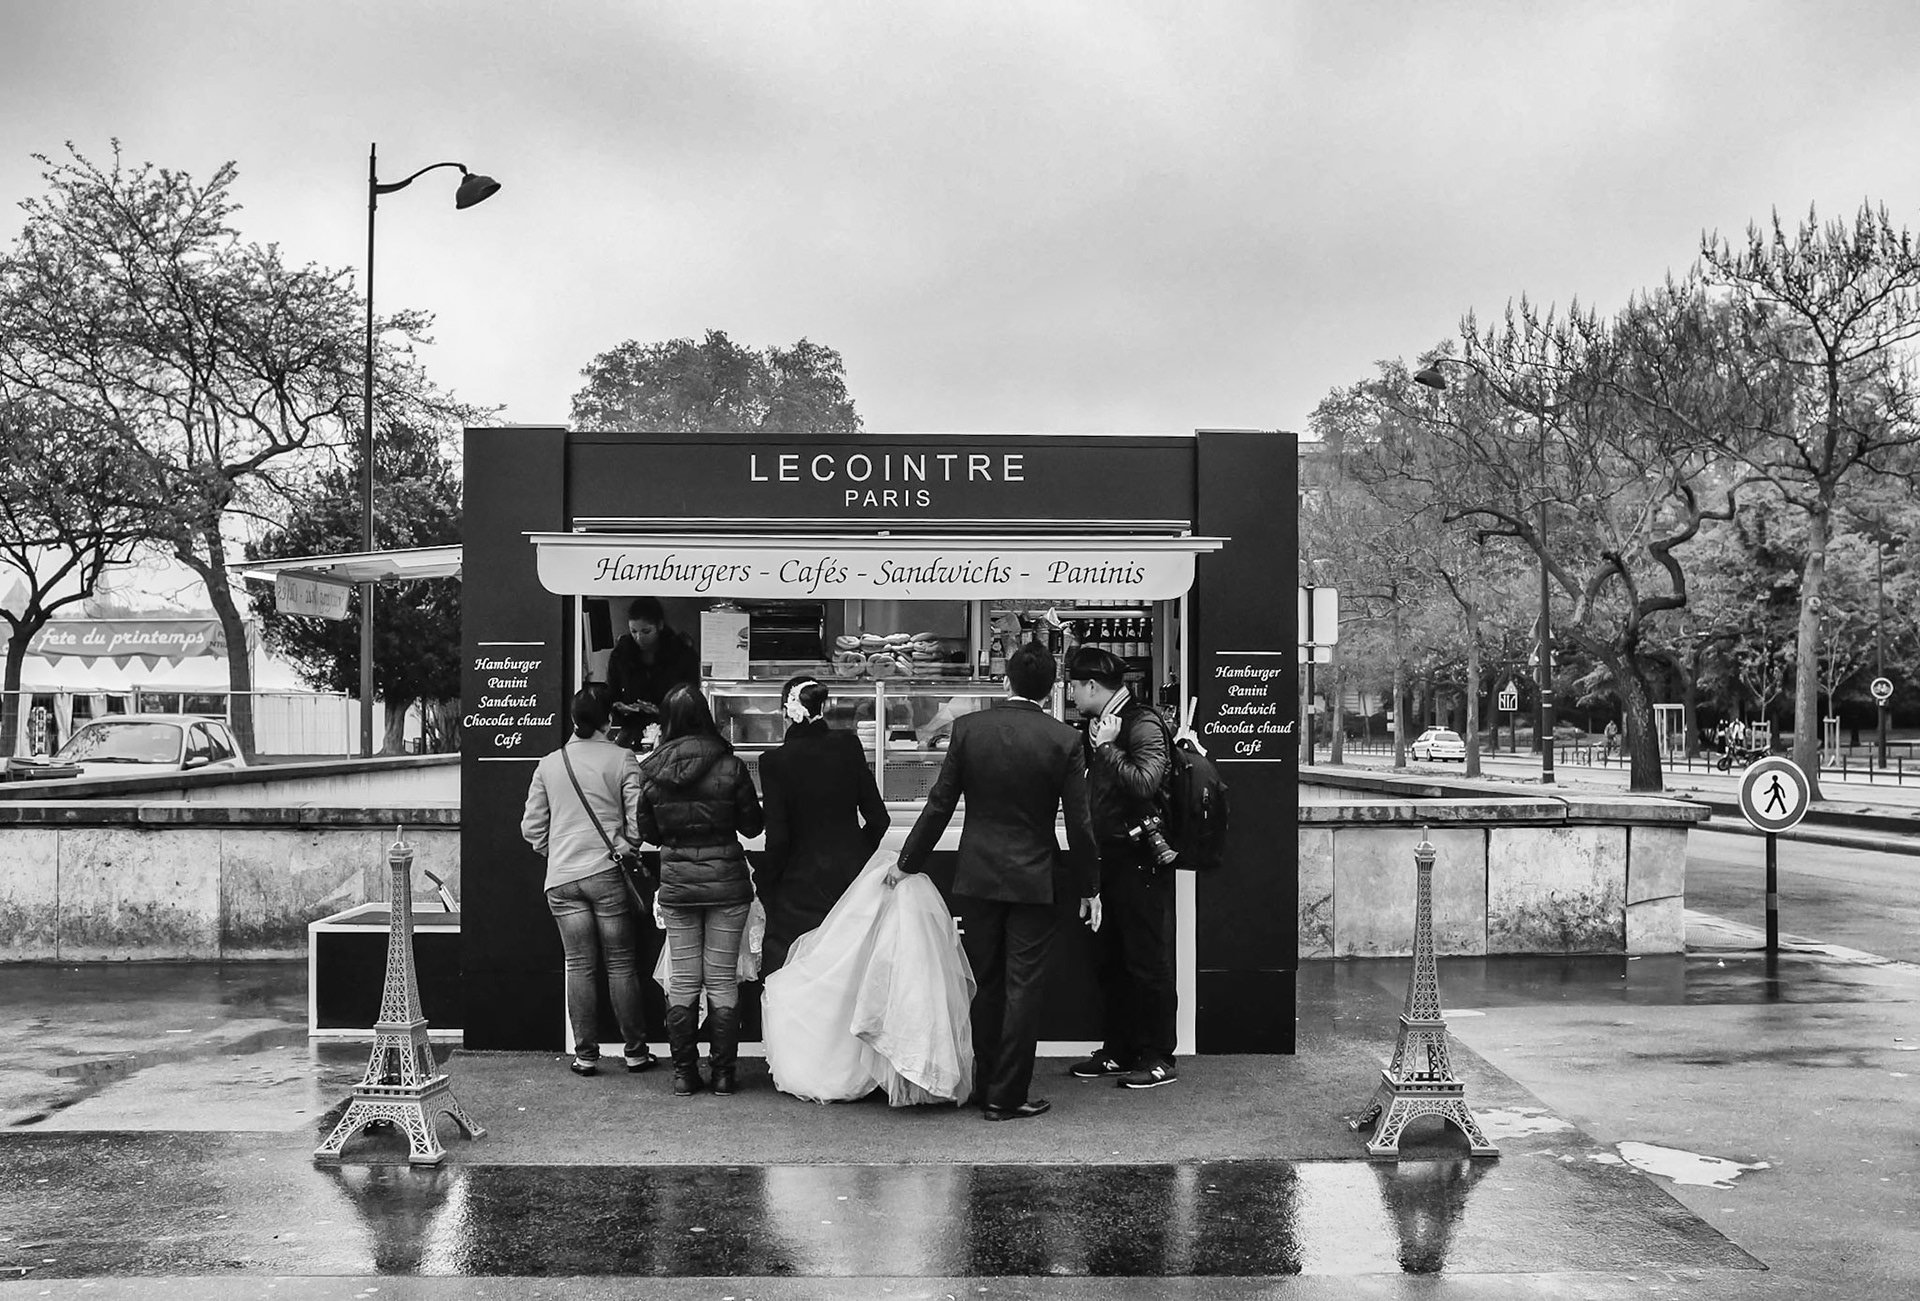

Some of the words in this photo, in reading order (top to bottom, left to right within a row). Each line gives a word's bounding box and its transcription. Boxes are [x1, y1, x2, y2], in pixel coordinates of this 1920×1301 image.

[750, 453, 1025, 482] LECOINTRE
[845, 489, 932, 508] PARIS
[593, 554, 752, 593] Hamburgers
[779, 557, 849, 593] Cafés
[873, 556, 1012, 586] Sandwichs
[1047, 560, 1146, 584] Paninis
[82, 627, 106, 645] du
[106, 630, 205, 653] printemps
[473, 656, 542, 673] Hamburger
[1214, 664, 1282, 682] Hamburger
[487, 676, 529, 689] Panini
[1227, 684, 1269, 697] Panini
[478, 694, 537, 708] Sandwich
[1218, 702, 1277, 716] Sandwich
[463, 713, 515, 728] Chocolat
[516, 713, 556, 726] chaud
[1204, 720, 1255, 735] Chocolat
[1256, 720, 1295, 734] chaud
[494, 732, 523, 749] Café
[1234, 739, 1262, 756] Café
